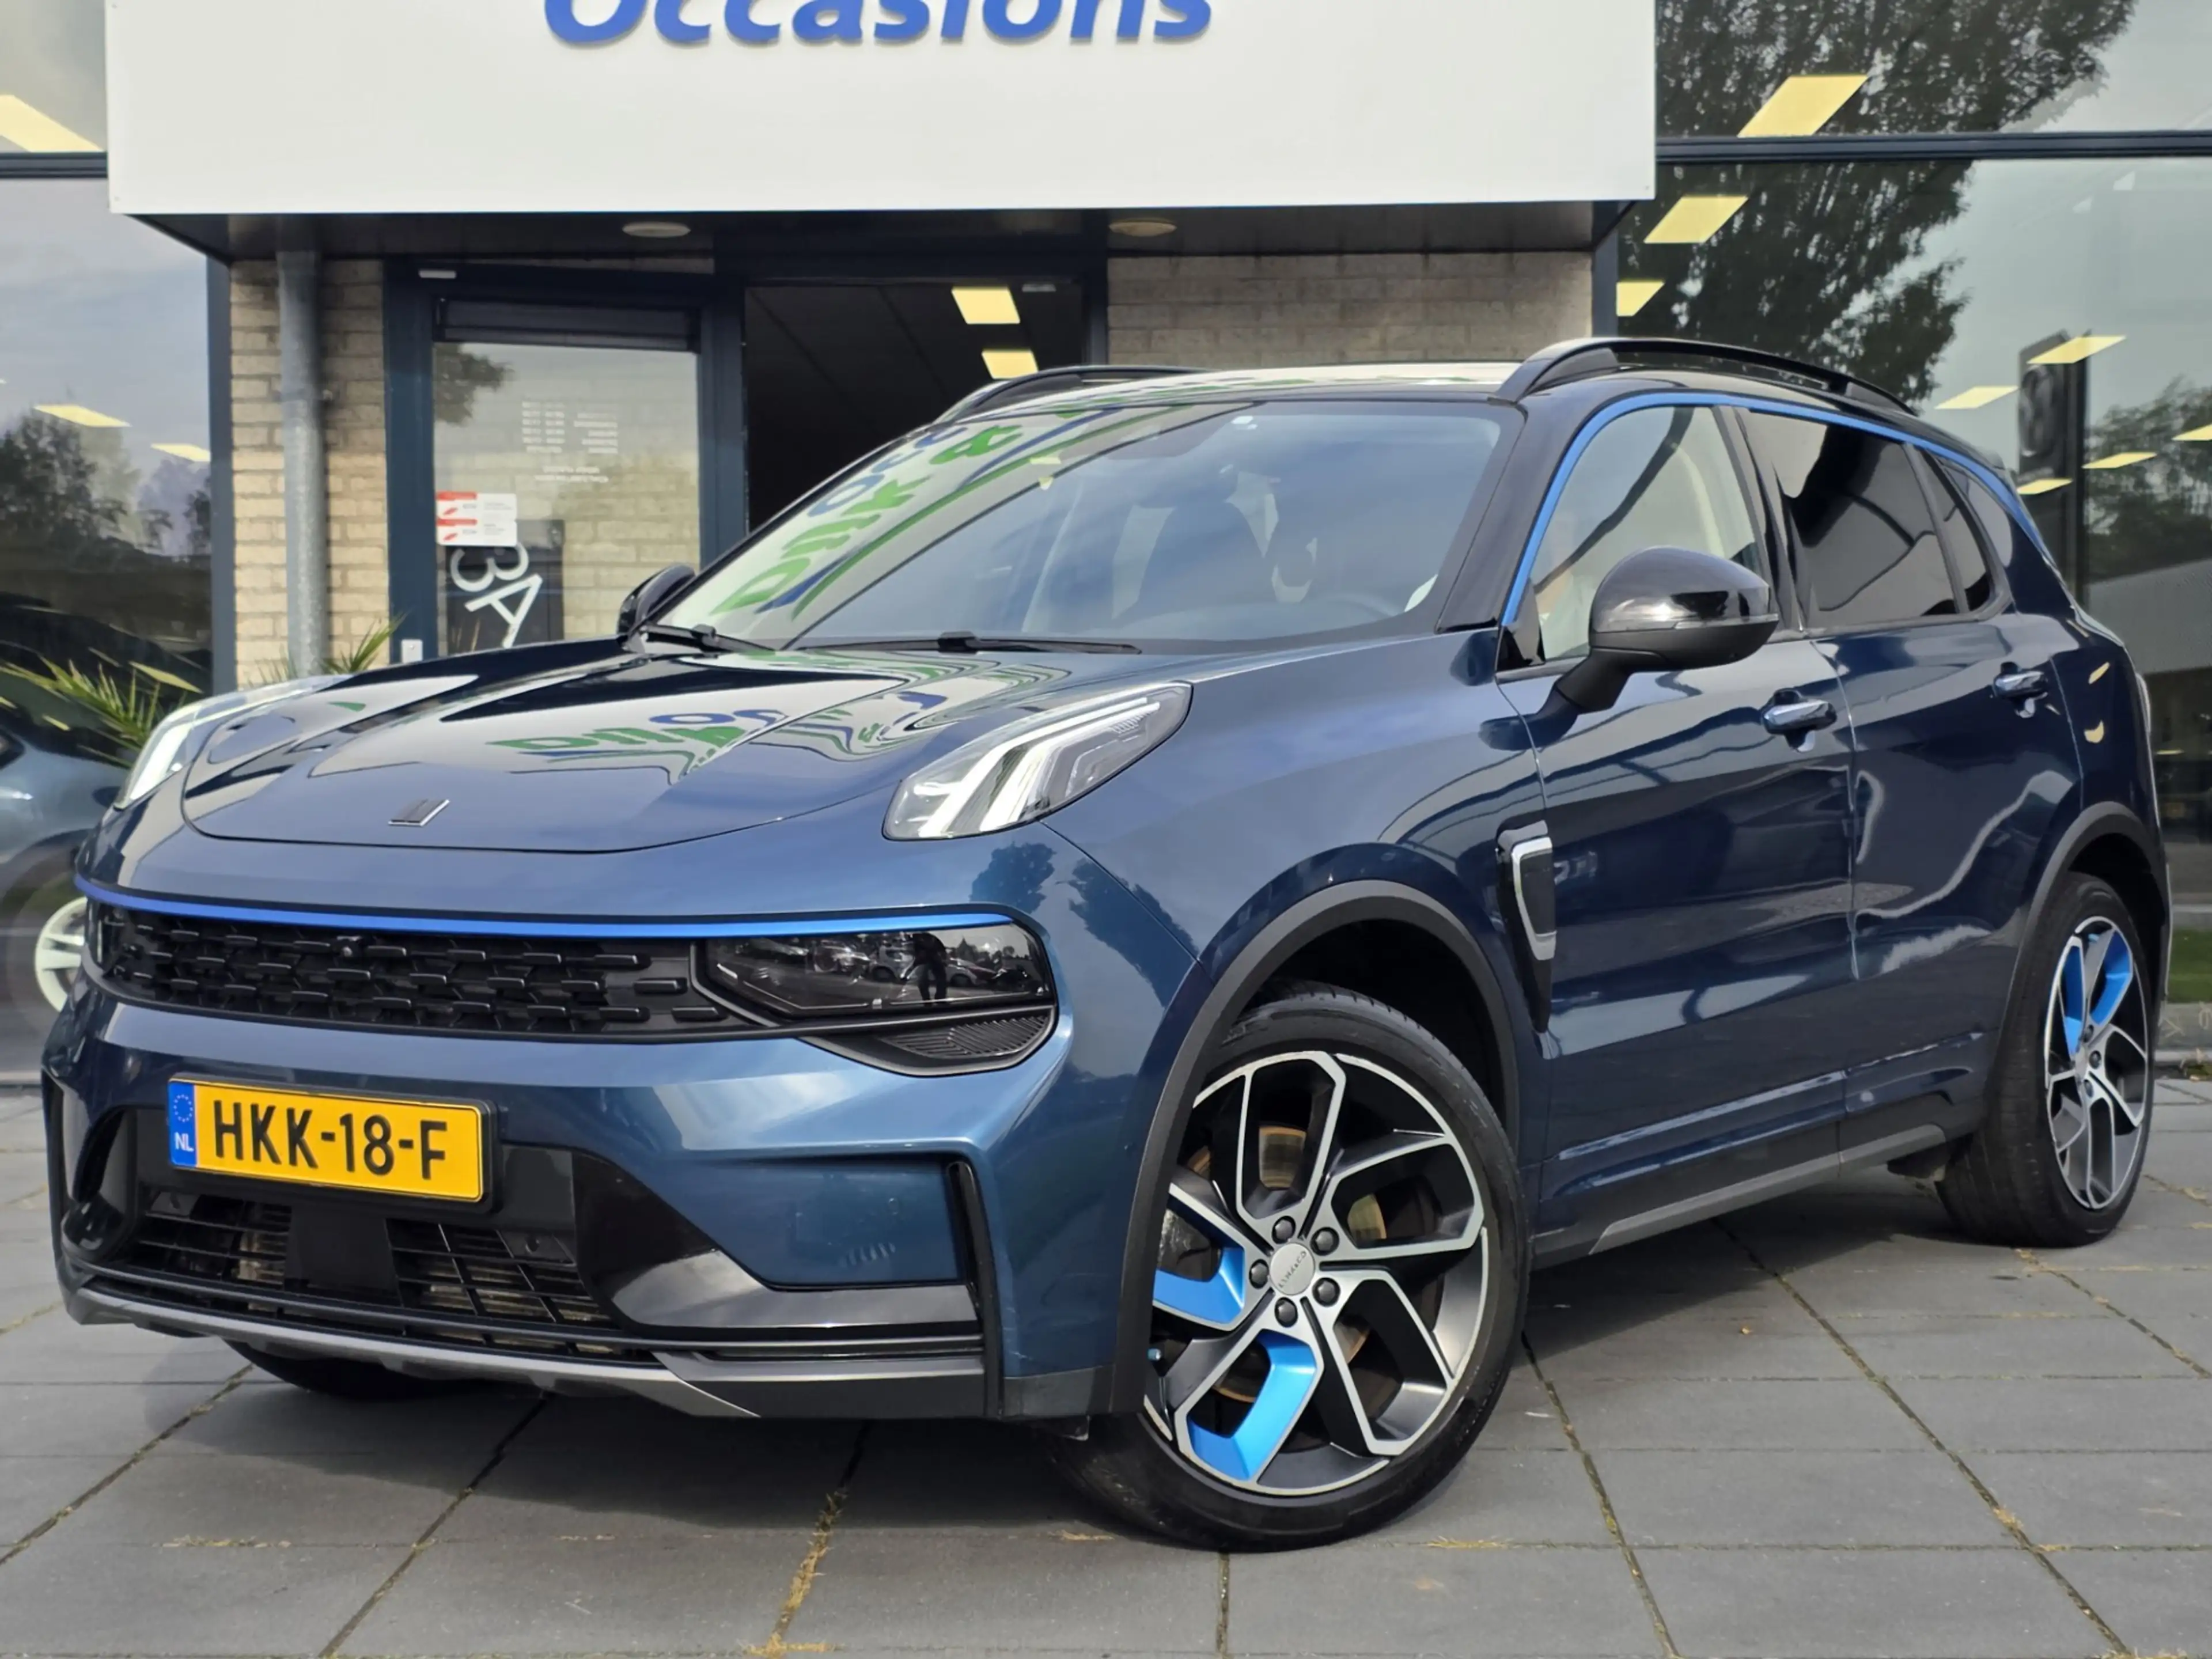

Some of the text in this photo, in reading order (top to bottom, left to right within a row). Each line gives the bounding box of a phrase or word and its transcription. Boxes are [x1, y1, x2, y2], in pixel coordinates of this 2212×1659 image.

[544, 0, 1211, 45] Occasions
[175, 1132, 194, 1152] NL
[213, 1100, 447, 1180] HKK-18-F
